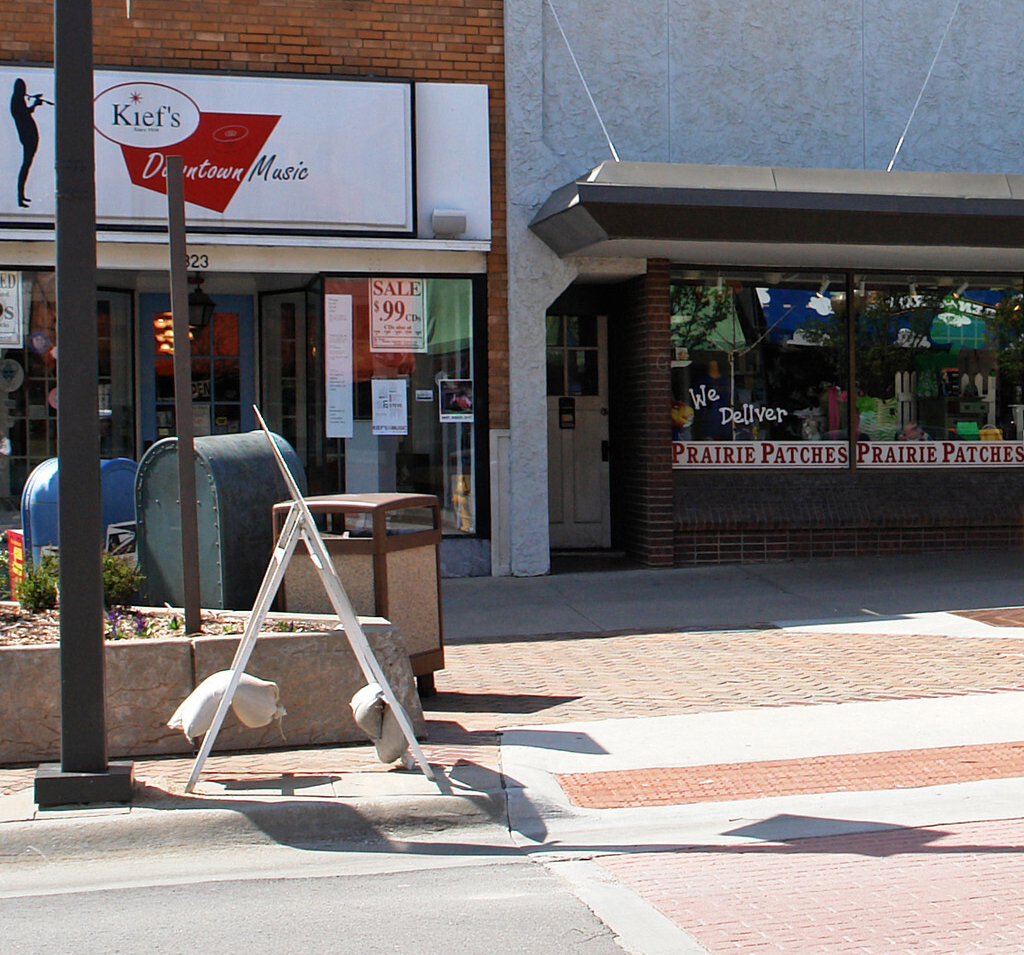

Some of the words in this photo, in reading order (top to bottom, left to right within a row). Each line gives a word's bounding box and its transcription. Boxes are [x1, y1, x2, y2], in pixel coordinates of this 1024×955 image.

[112, 103, 181, 128] Kief's
[142, 152, 244, 182] Dontown
[248, 154, 309, 182] Music
[373, 280, 422, 297] SALE
[688, 384, 720, 410] We
[672, 442, 756, 464] PRAIRIE
[760, 442, 848, 464] PATCHES
[857, 442, 937, 464] PRAIRIE
[942, 442, 1024, 463] PATCHES
